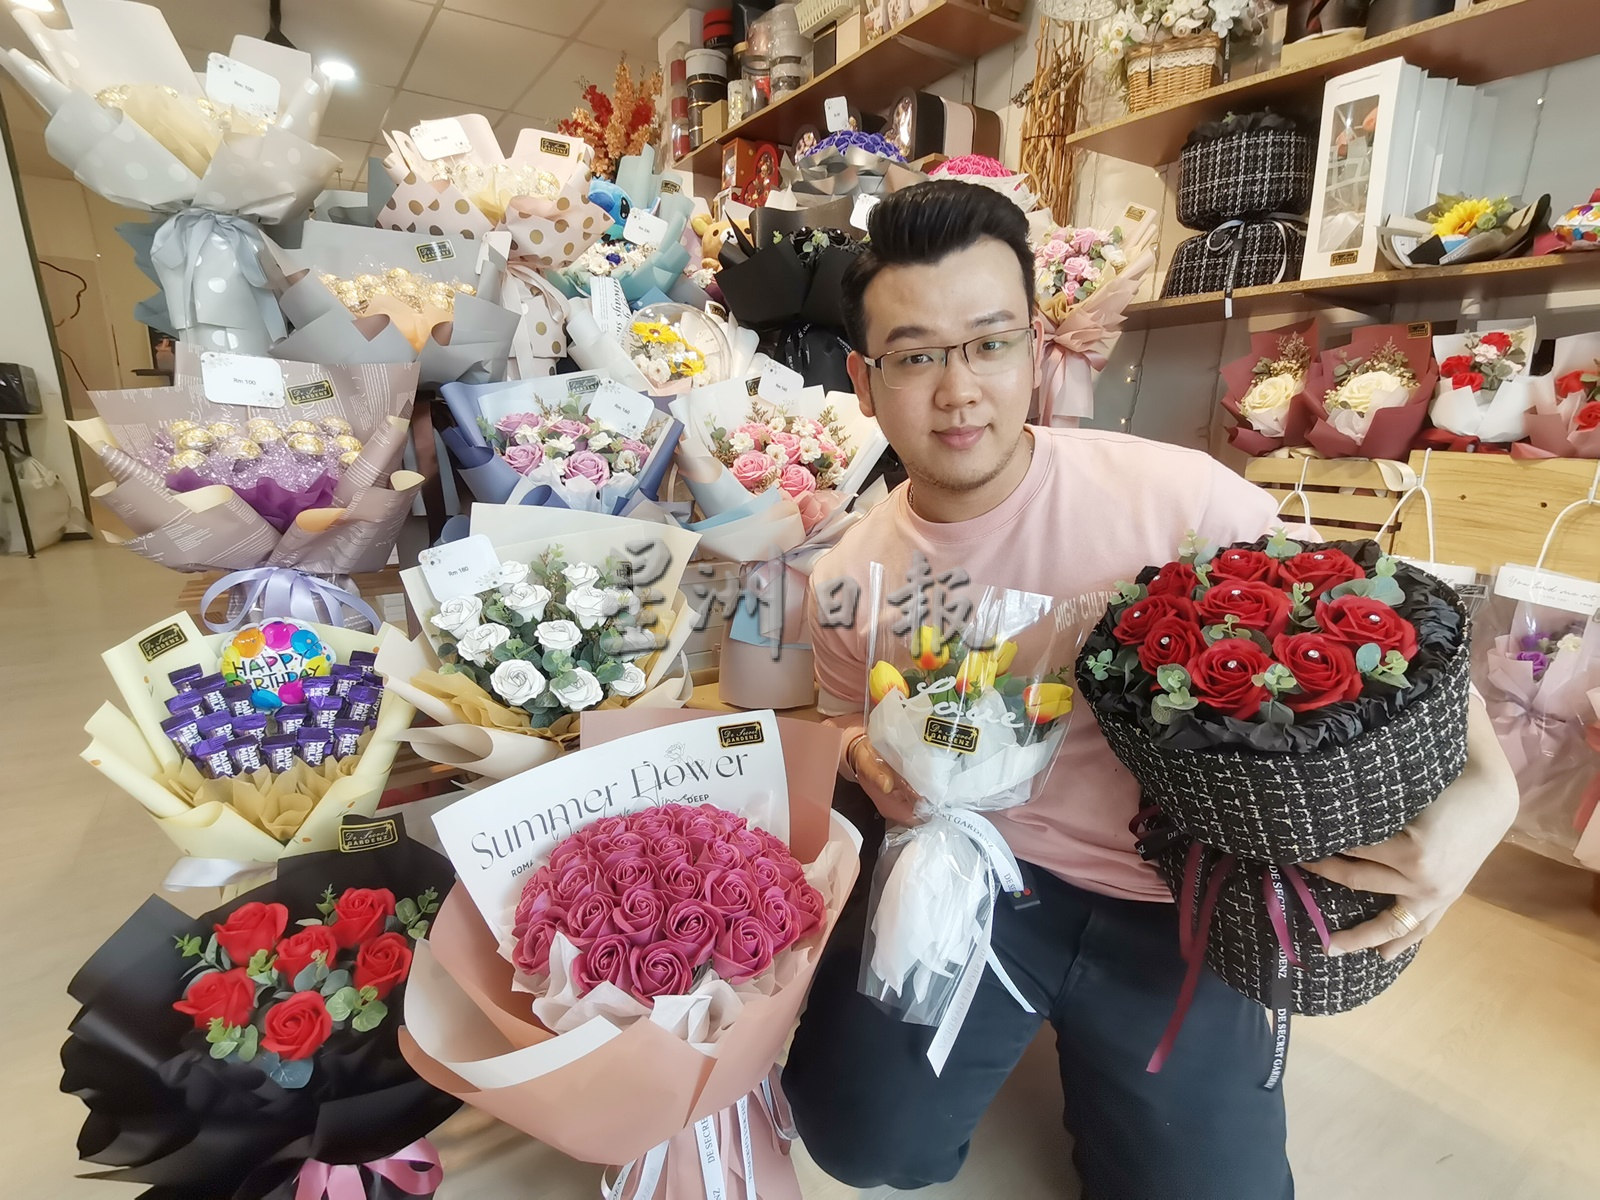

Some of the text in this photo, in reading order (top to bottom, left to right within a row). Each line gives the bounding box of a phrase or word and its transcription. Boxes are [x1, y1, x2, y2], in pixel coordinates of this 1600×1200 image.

[1053, 597, 1078, 633] HIGH
[232, 645, 312, 677] HAPPY
[230, 664, 320, 691] RTHDAY
[208, 691, 222, 713] MILK
[320, 710, 329, 729] MILK
[180, 726, 197, 747] MILK
[341, 733, 352, 754] MILK
[726, 734, 758, 743] GARDENZ
[240, 747, 251, 770] MILK
[248, 743, 260, 770] DAIRY
[276, 748, 285, 769] MILK
[284, 746, 293, 771] DAIRY
[307, 741, 316, 762] MILK
[314, 741, 325, 766] DAIRY
[211, 753, 223, 775] MILK
[219, 749, 234, 777] DAIRY
[686, 793, 710, 804] DEEP
[471, 781, 618, 870] Summer
[630, 751, 749, 799] Flower
[347, 834, 388, 846] GARDENZ
[1268, 864, 1281, 880] DE
[1277, 1008, 1287, 1023] DE
[1274, 1023, 1287, 1058] SECRET
[701, 1117, 716, 1164] DE SECRE
